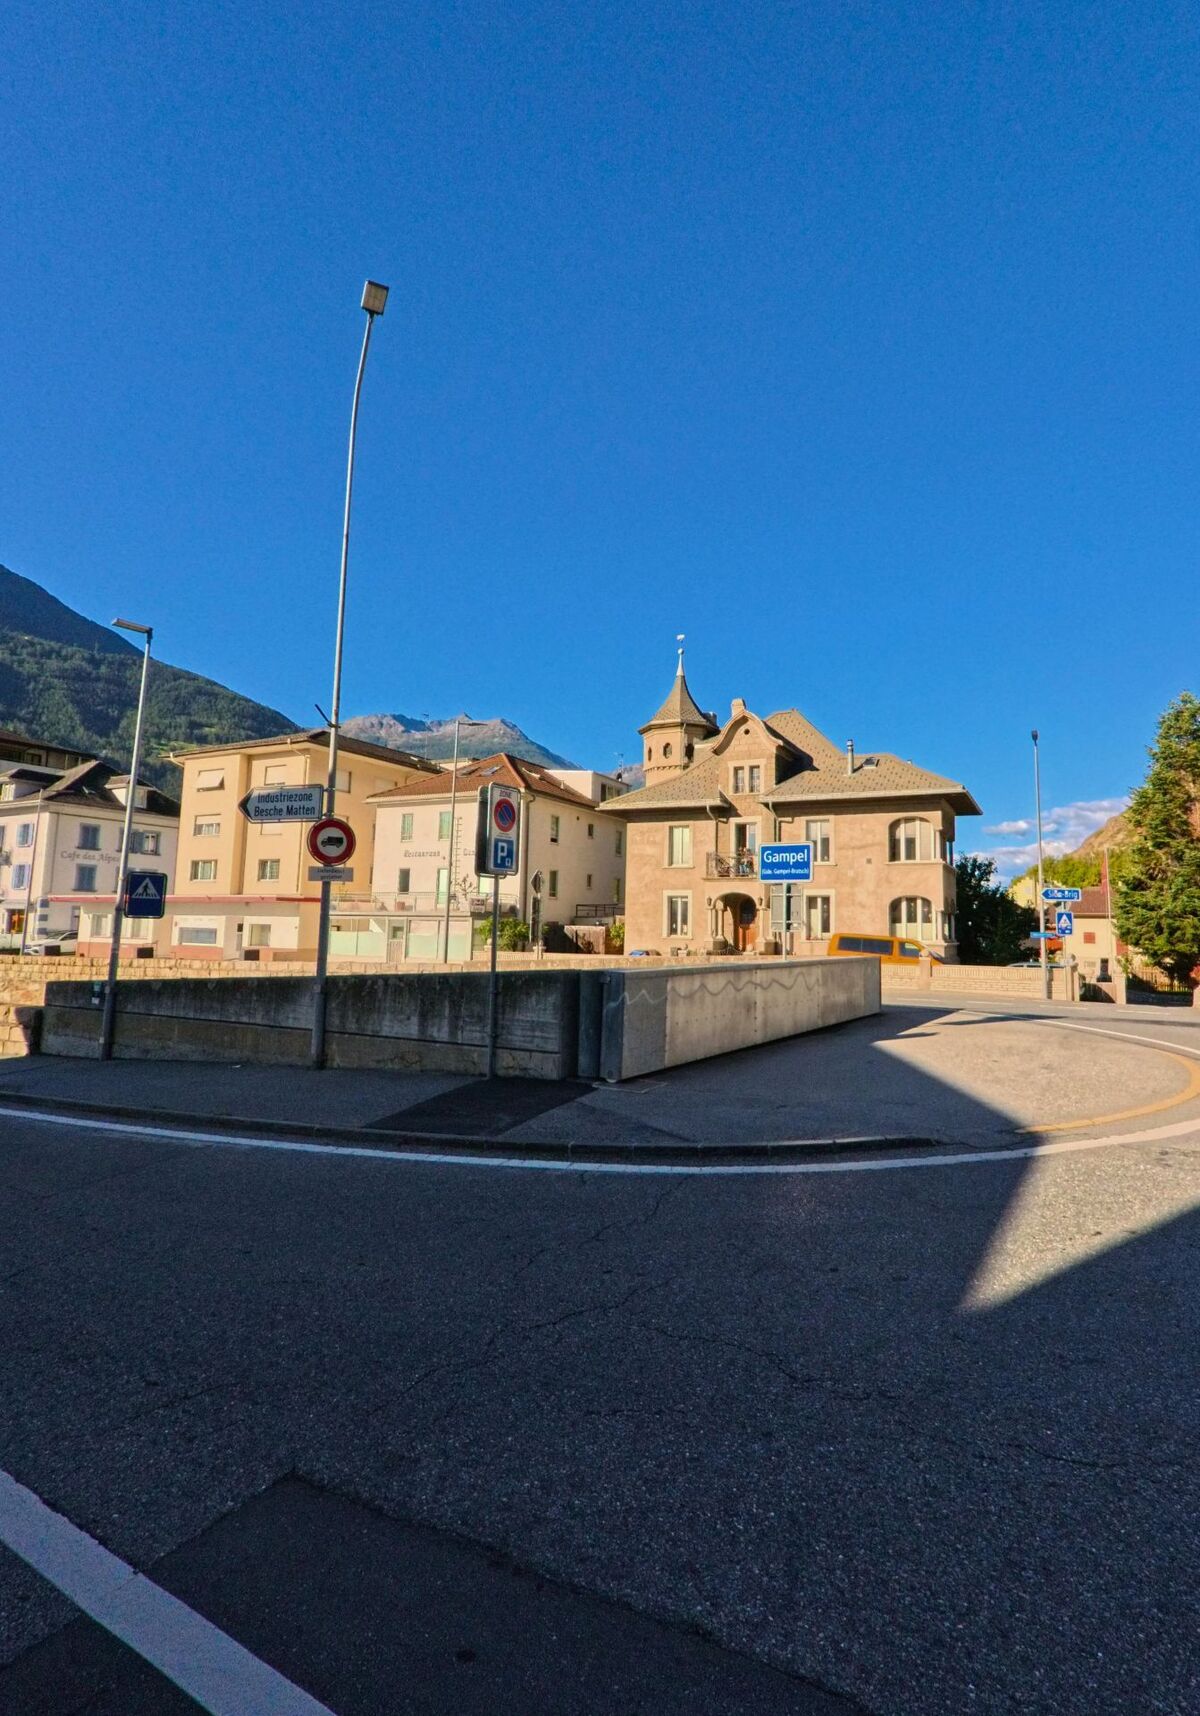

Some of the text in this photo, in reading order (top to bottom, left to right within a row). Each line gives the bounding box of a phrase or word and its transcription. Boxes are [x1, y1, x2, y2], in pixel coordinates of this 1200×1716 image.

[257, 791, 313, 803] Industriezone
[254, 804, 315, 817] Besche Matten
[498, 841, 508, 864] P
[763, 848, 808, 865] Gampel
